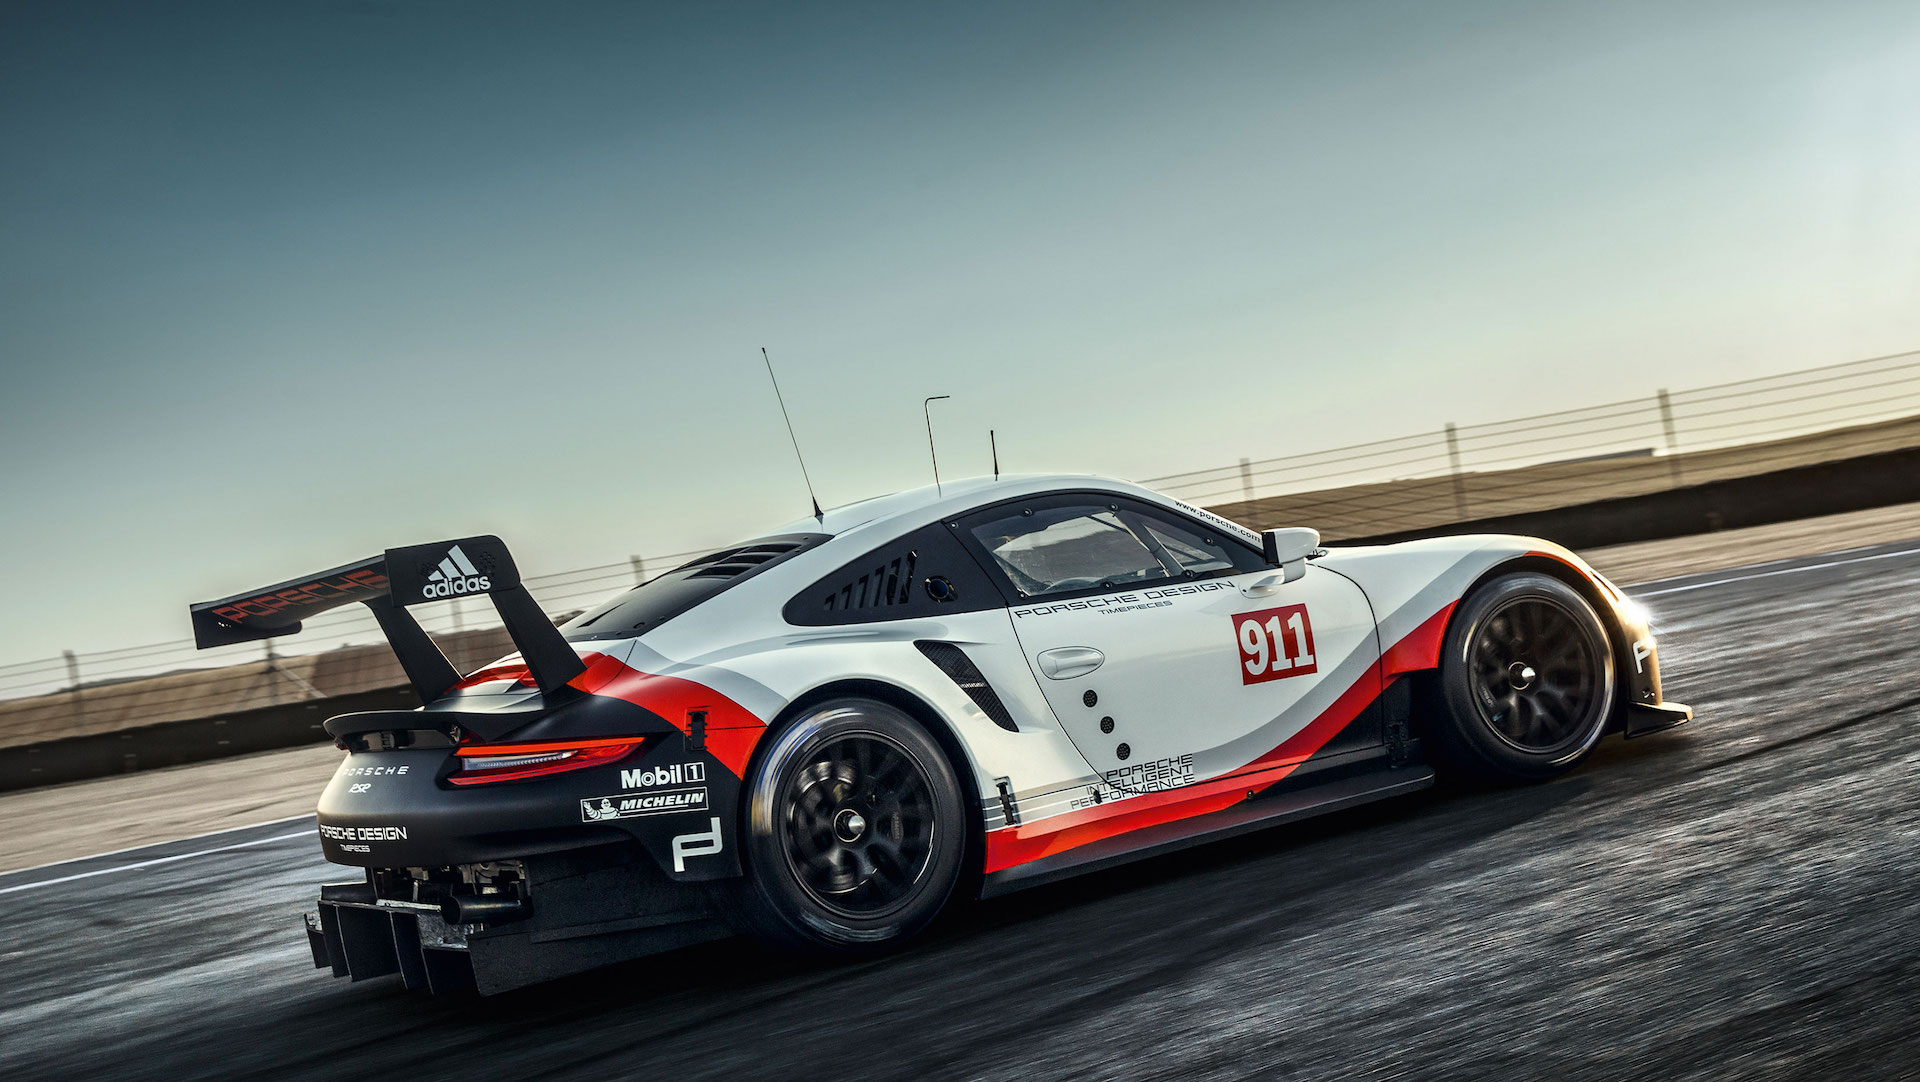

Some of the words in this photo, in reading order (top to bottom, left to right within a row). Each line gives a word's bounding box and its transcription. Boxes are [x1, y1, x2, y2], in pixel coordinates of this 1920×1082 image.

[212, 570, 389, 624] PORSCHE
[422, 576, 491, 598] adidas
[1014, 594, 1140, 619] PORSCHE
[1144, 580, 1235, 600] DESIGN
[1097, 600, 1173, 615] TIMEPIECES
[1240, 611, 1315, 676] 911
[621, 764, 682, 789] Mobil
[1086, 764, 1193, 795] INTELLIGENT
[1106, 754, 1193, 780] PORSCHE
[620, 792, 704, 810] MICHELIN
[1070, 773, 1196, 810] PERFORMANCE
[320, 824, 356, 840] PORSCHE
[357, 826, 408, 840] DESIGN
